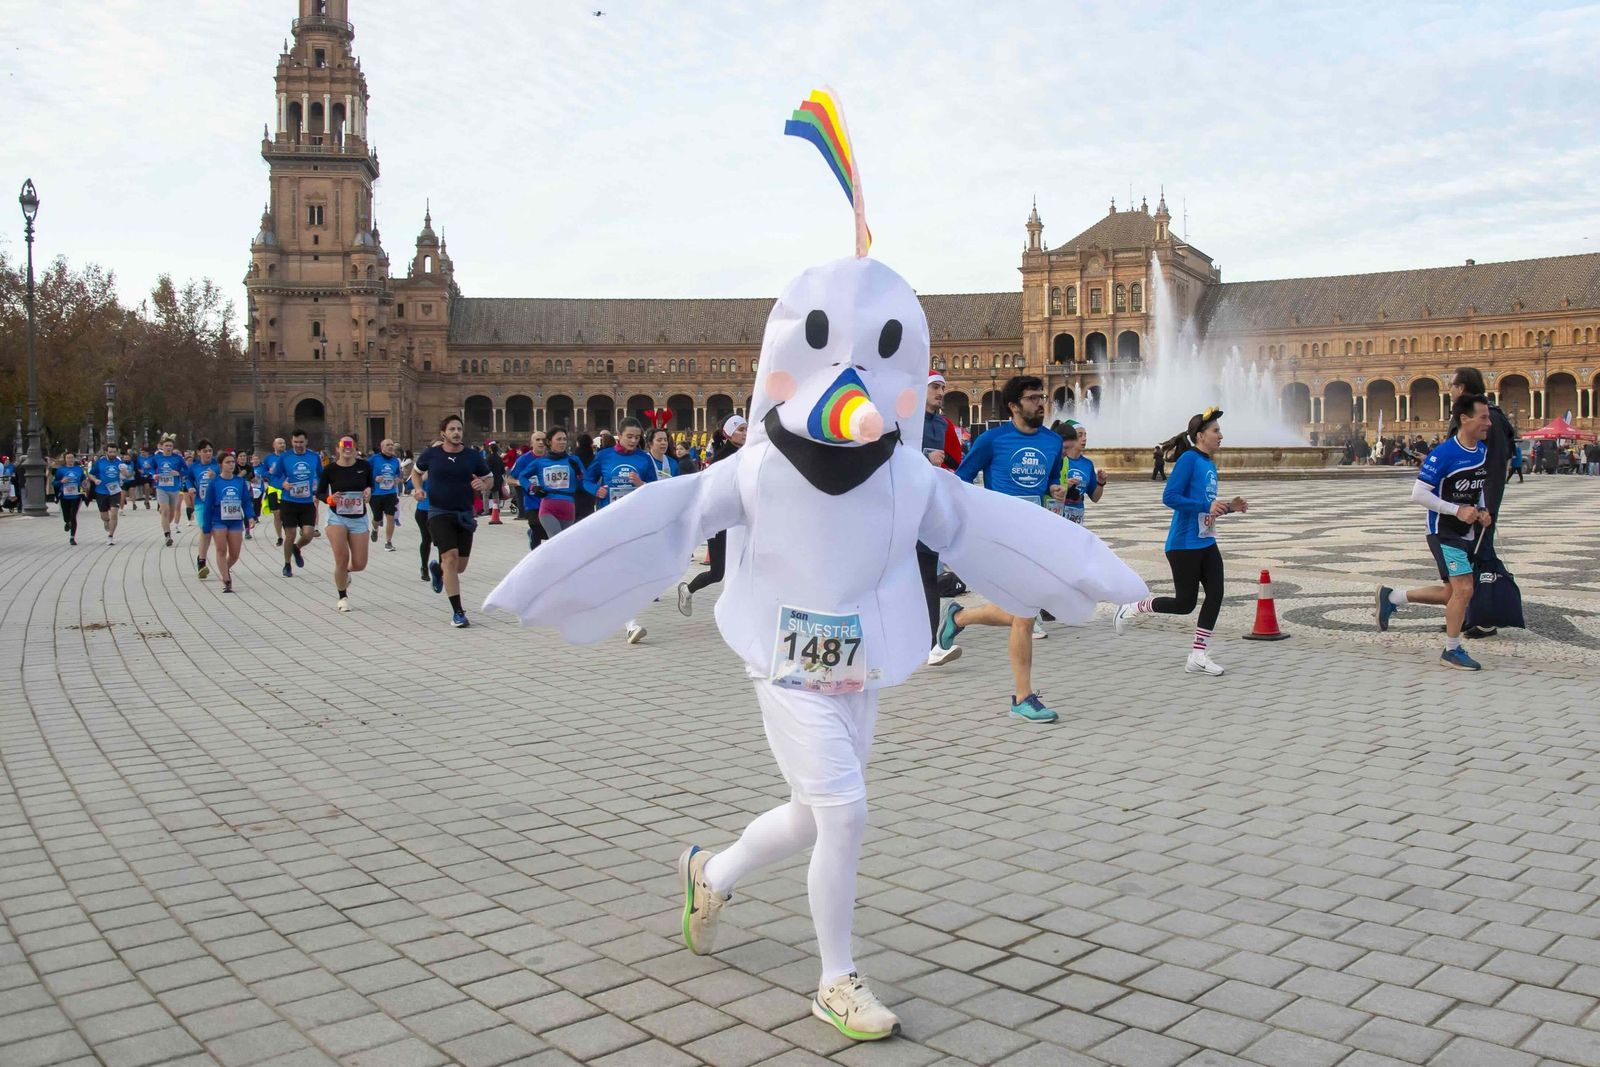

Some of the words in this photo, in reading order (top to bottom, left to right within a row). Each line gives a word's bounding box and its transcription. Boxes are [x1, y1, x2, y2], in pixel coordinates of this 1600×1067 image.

[1011, 467, 1046, 476] SEVILLANA
[787, 618, 857, 638] SILVESTRE
[783, 632, 862, 667] 1487
